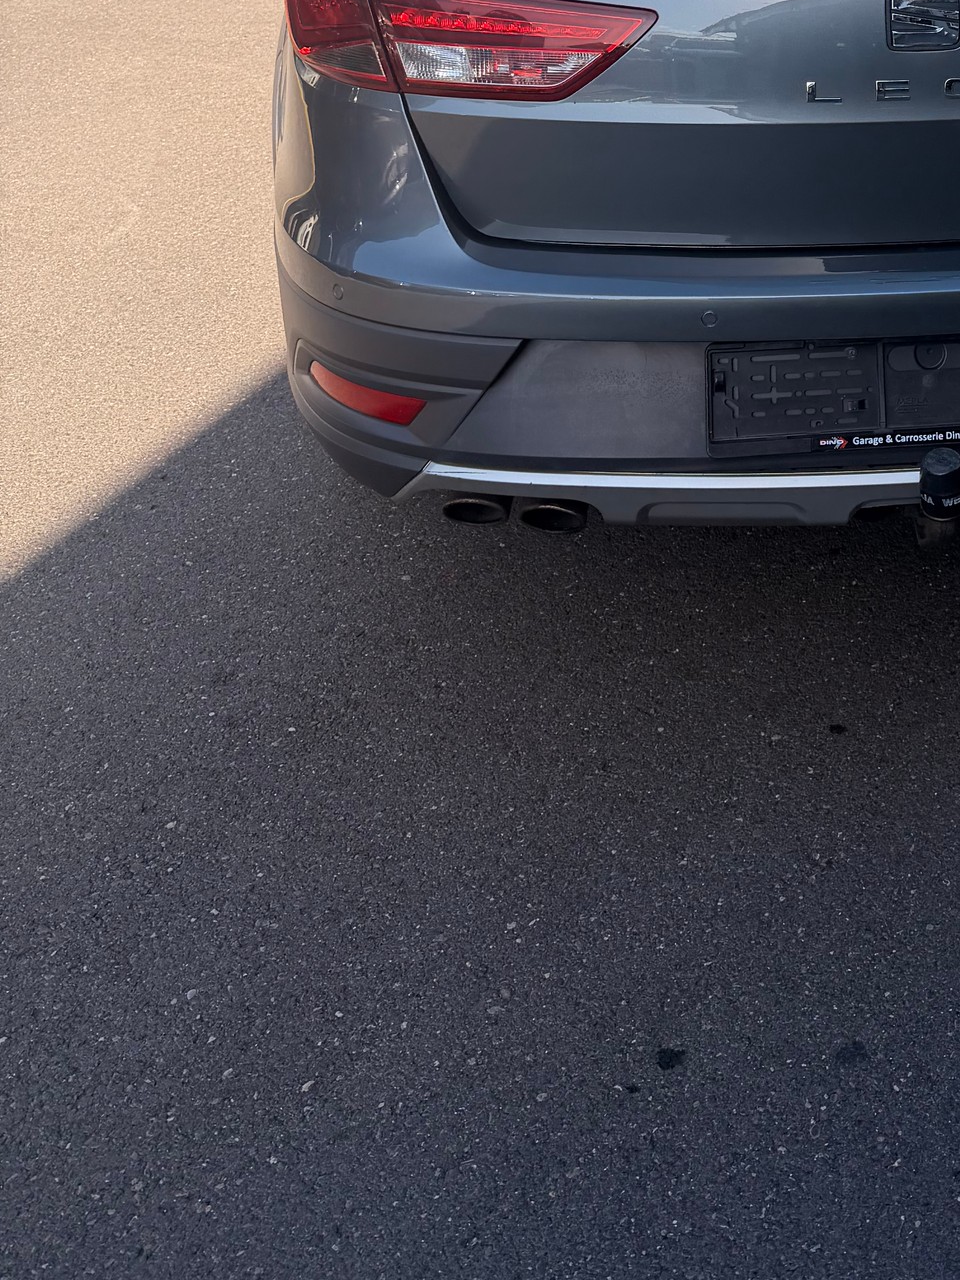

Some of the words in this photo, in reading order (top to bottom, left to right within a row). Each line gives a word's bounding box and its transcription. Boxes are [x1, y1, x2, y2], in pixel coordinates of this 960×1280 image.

[819, 439, 844, 447] DINO
[852, 436, 884, 446] Garage
[886, 434, 893, 443] &
[895, 431, 944, 443] Carrosserie
